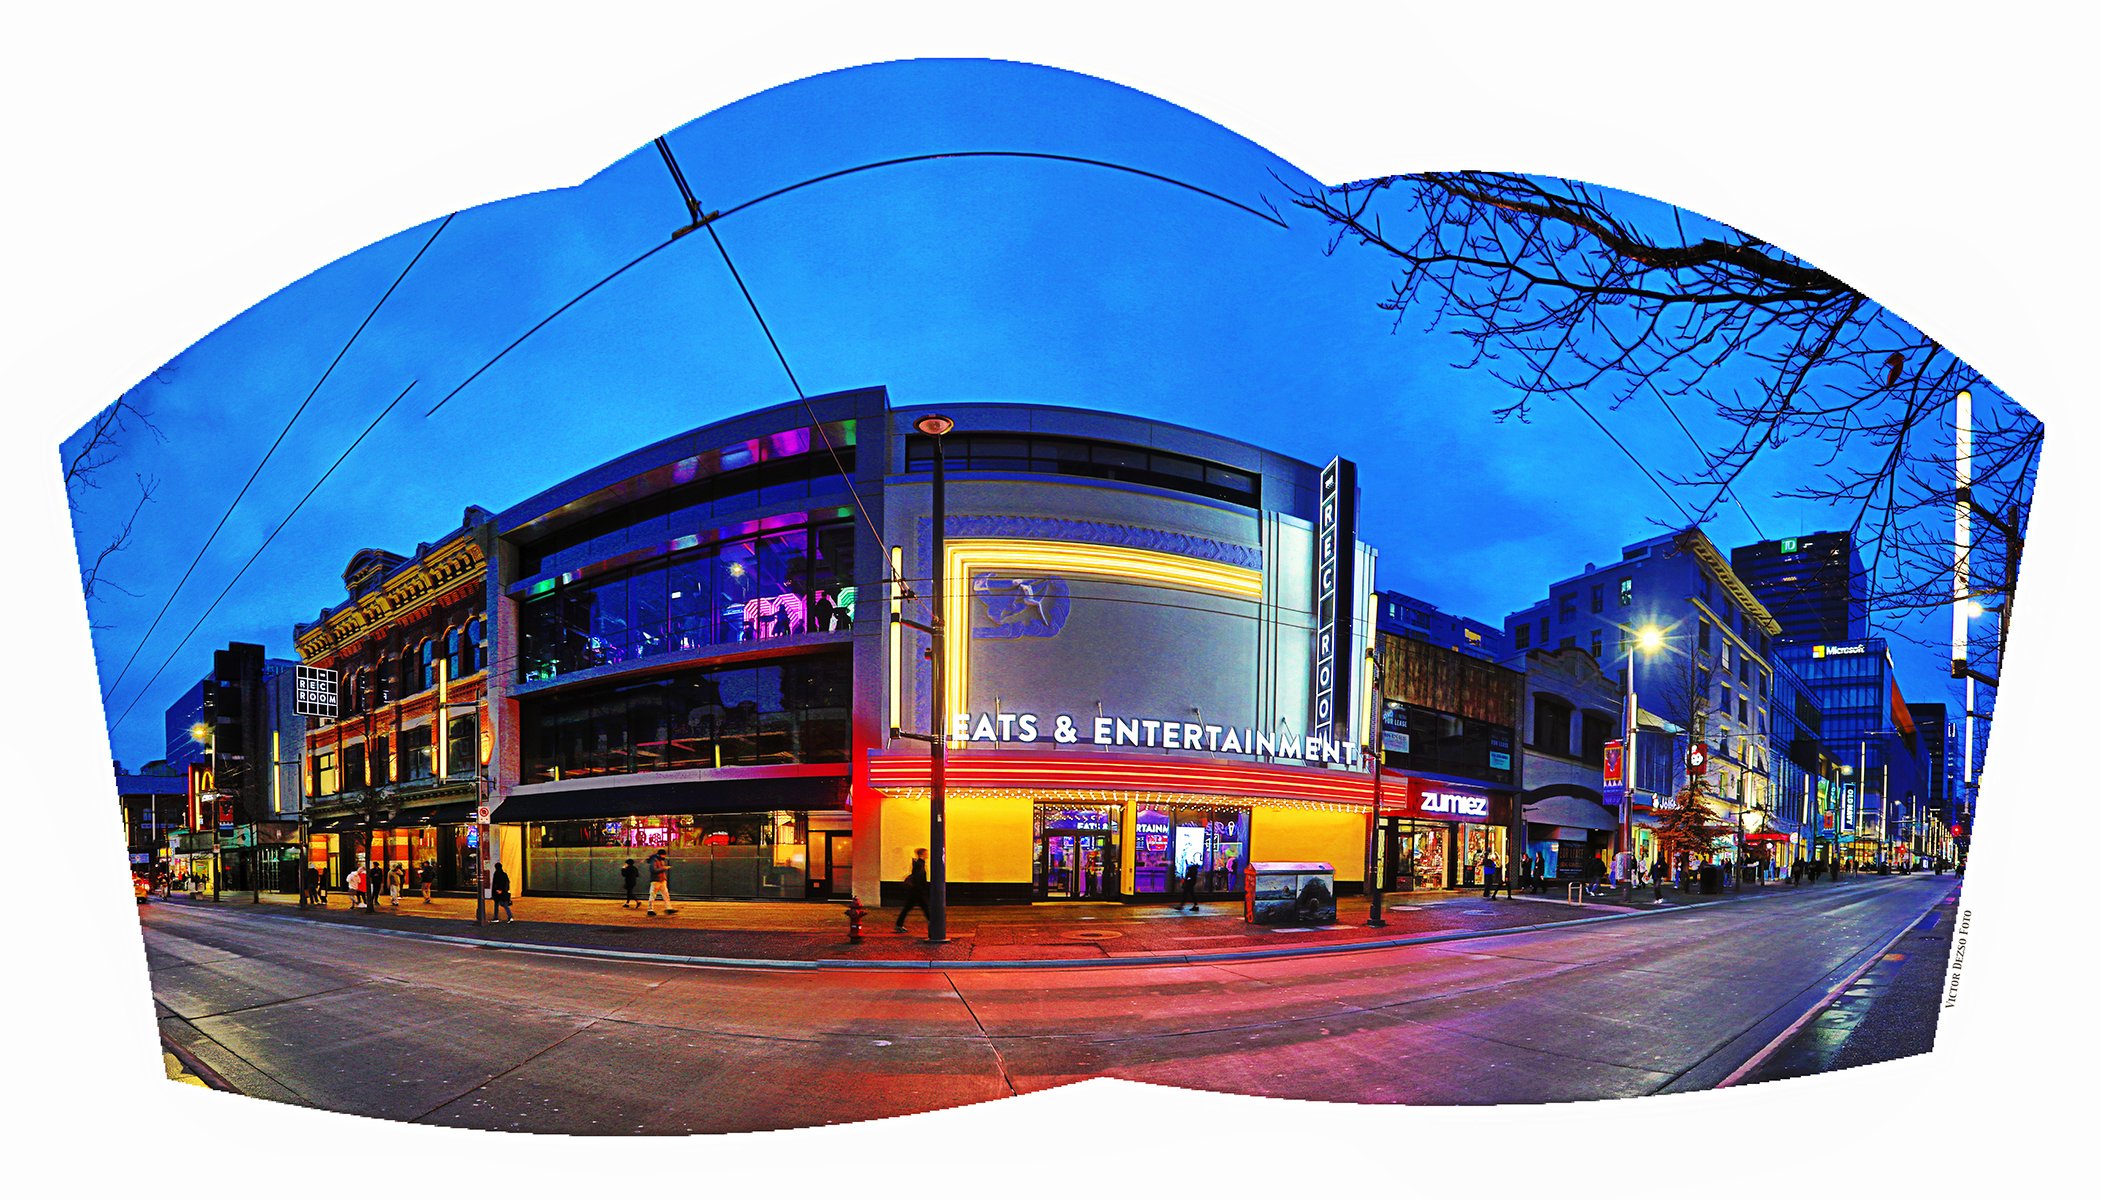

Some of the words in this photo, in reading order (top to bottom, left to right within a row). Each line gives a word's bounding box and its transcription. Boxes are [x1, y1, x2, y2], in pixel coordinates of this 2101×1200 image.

[1323, 504, 1333, 589] REC
[1782, 540, 1796, 550] TD
[1826, 644, 1865, 656] Microsoft
[299, 680, 326, 691] REC
[299, 691, 336, 704] ROOM
[951, 712, 1038, 742] EATS
[1053, 715, 1078, 744] &
[1093, 717, 1357, 765] ENTERTAINMENT
